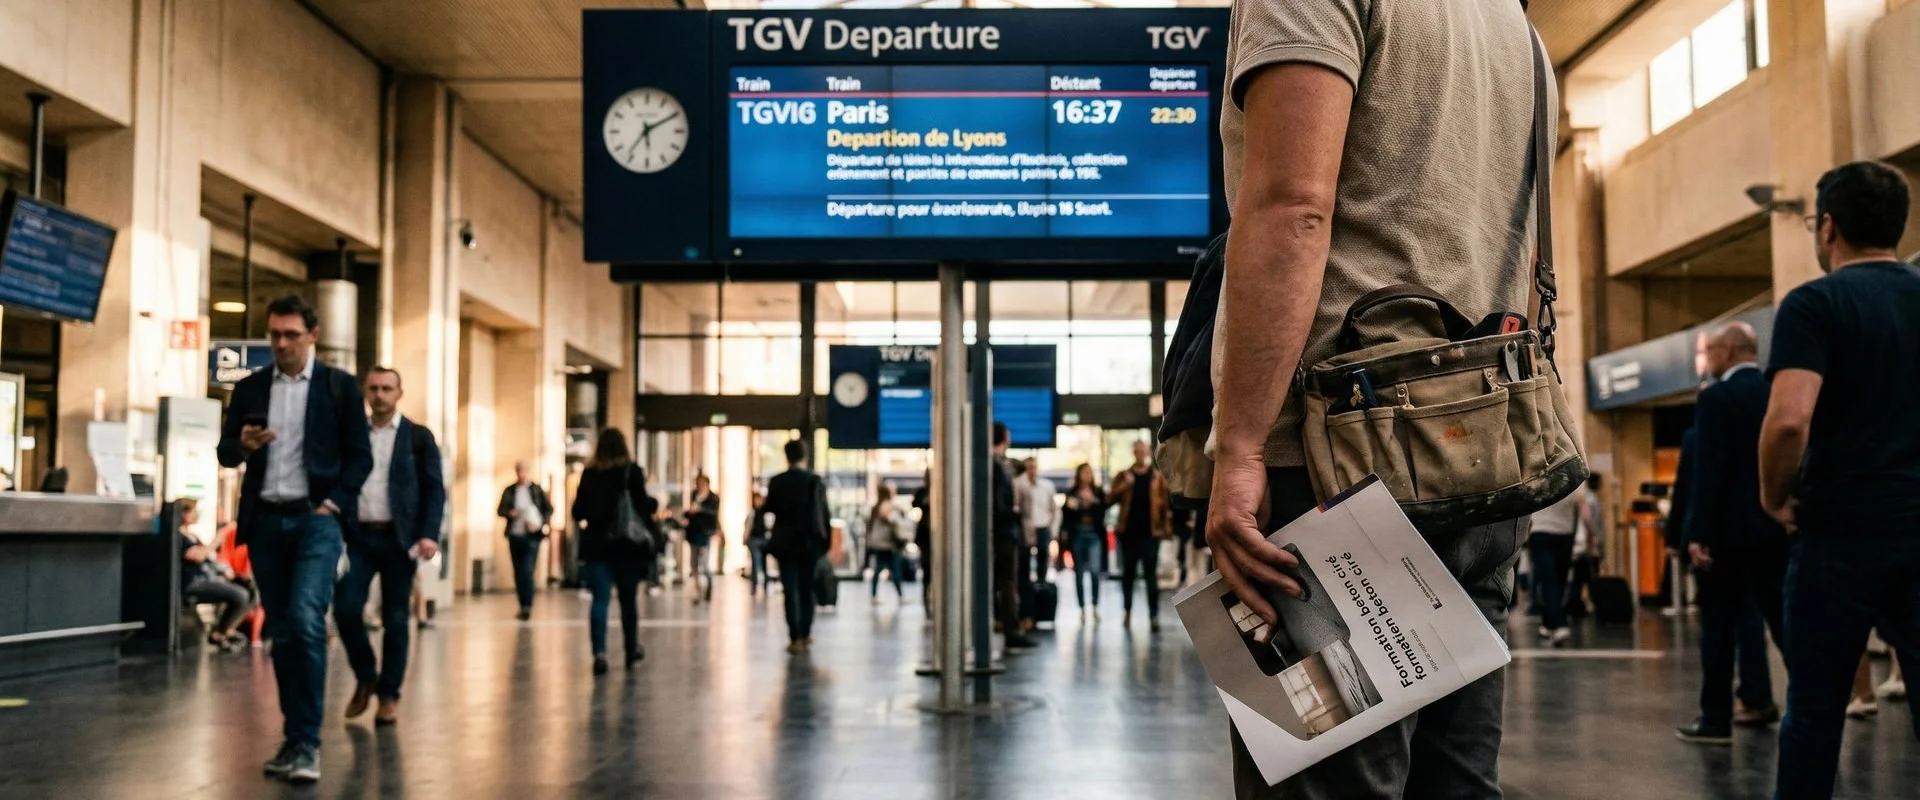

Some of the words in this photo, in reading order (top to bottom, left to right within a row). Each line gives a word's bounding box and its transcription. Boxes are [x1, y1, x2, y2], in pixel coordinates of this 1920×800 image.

[727, 17, 813, 50] TGV
[824, 20, 1000, 58] Departure
[1146, 26, 1211, 50] TGV
[736, 76, 771, 92] Train
[826, 76, 861, 91] Train
[827, 100, 889, 124] Paris
[1052, 100, 1122, 124] 16:37
[1150, 107, 1197, 124] 22:30
[924, 128, 949, 147] de
[953, 129, 1007, 150] Lyons
[1325, 555, 1346, 579] ciré
[1341, 551, 1363, 576] ciré
[1344, 580, 1371, 617] beton
[1360, 578, 1389, 617] beton
[1368, 617, 1414, 689] Formation
